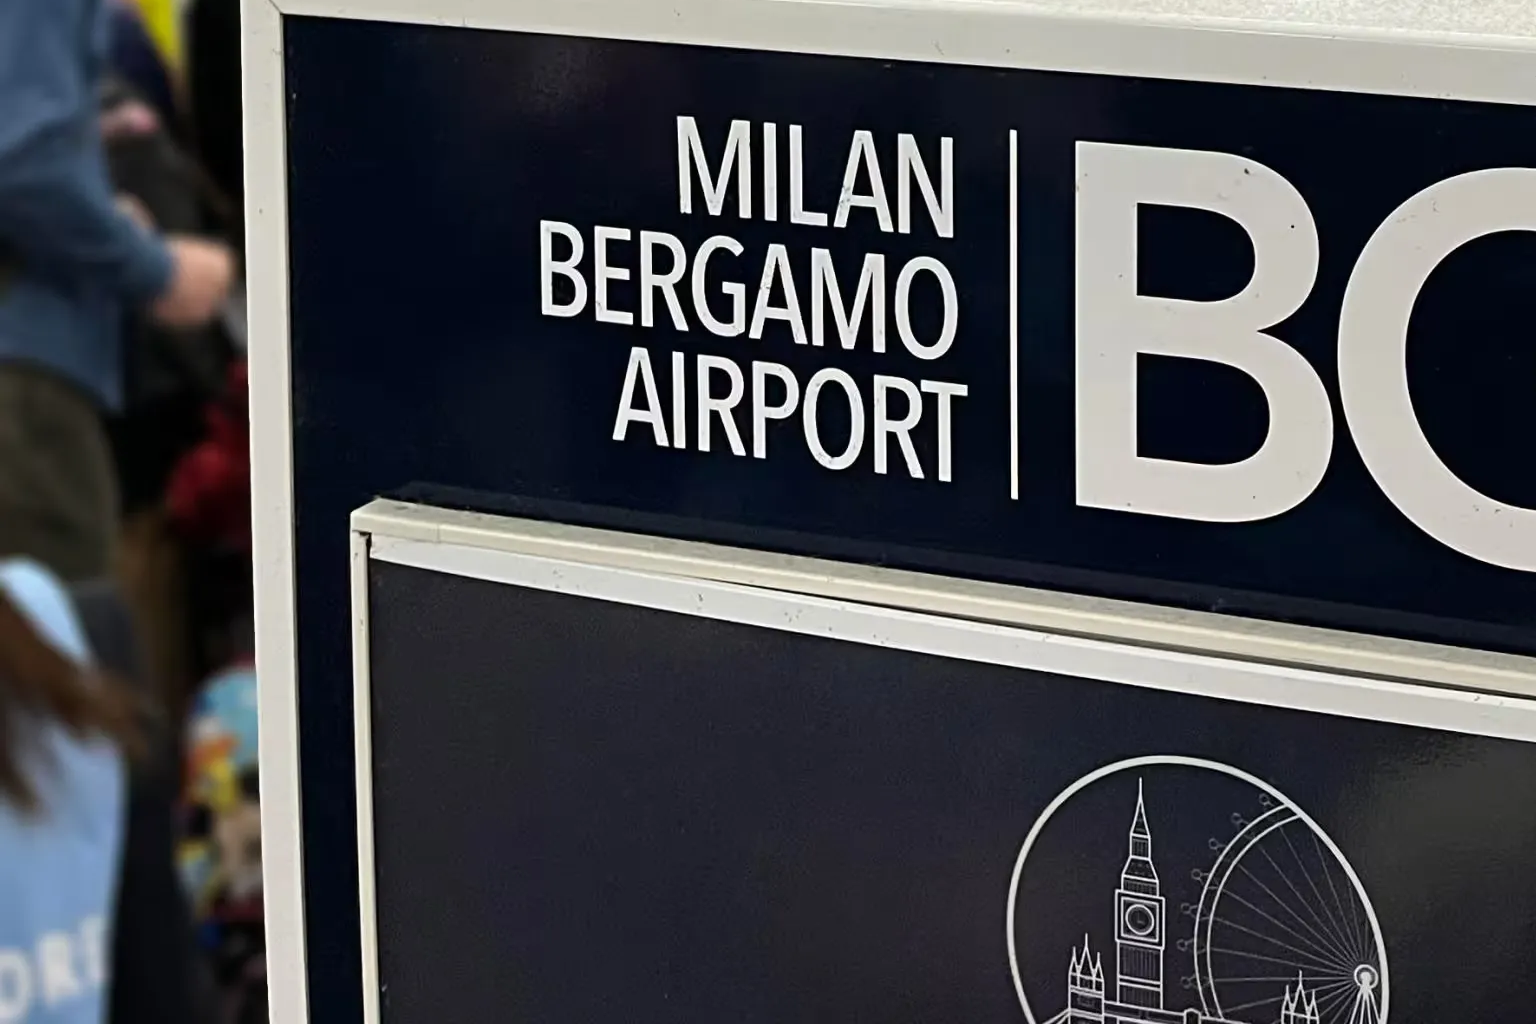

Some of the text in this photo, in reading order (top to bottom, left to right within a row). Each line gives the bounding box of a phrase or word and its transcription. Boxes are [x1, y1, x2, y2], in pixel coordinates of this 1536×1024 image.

[676, 115, 954, 239] MILAN
[539, 219, 959, 360] BERGAMO
[612, 346, 969, 483] AIRPORT
